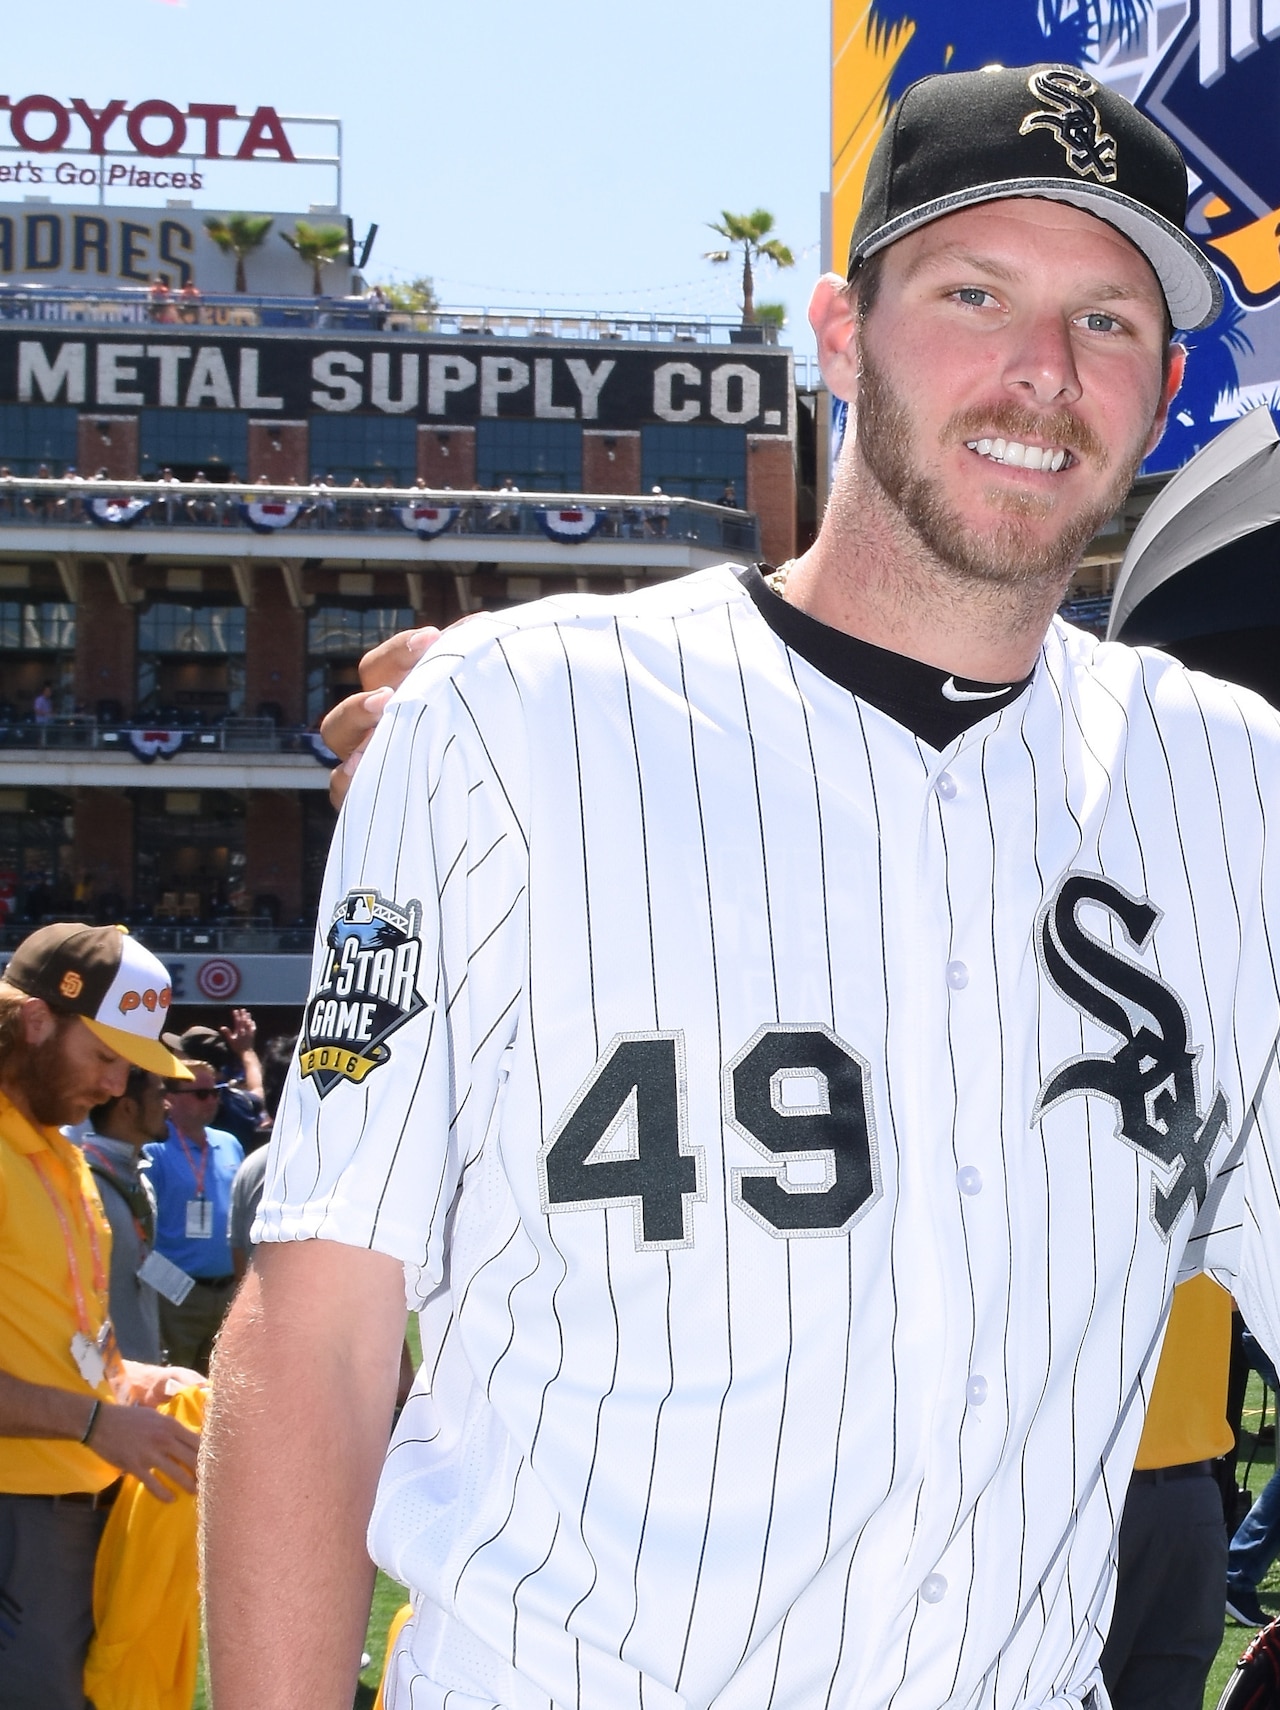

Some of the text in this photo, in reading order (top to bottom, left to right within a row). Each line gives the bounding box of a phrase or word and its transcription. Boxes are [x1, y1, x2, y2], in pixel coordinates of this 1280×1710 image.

[0, 94, 297, 163] OYOTA
[55, 161, 98, 186] Go
[106, 163, 207, 190] Places
[17, 341, 782, 426] METAL SUPPLY CO.
[335, 936, 420, 1014] STAR
[309, 999, 378, 1042] GAME
[306, 1053, 359, 1074] 2016
[537, 1021, 884, 1253] 49
